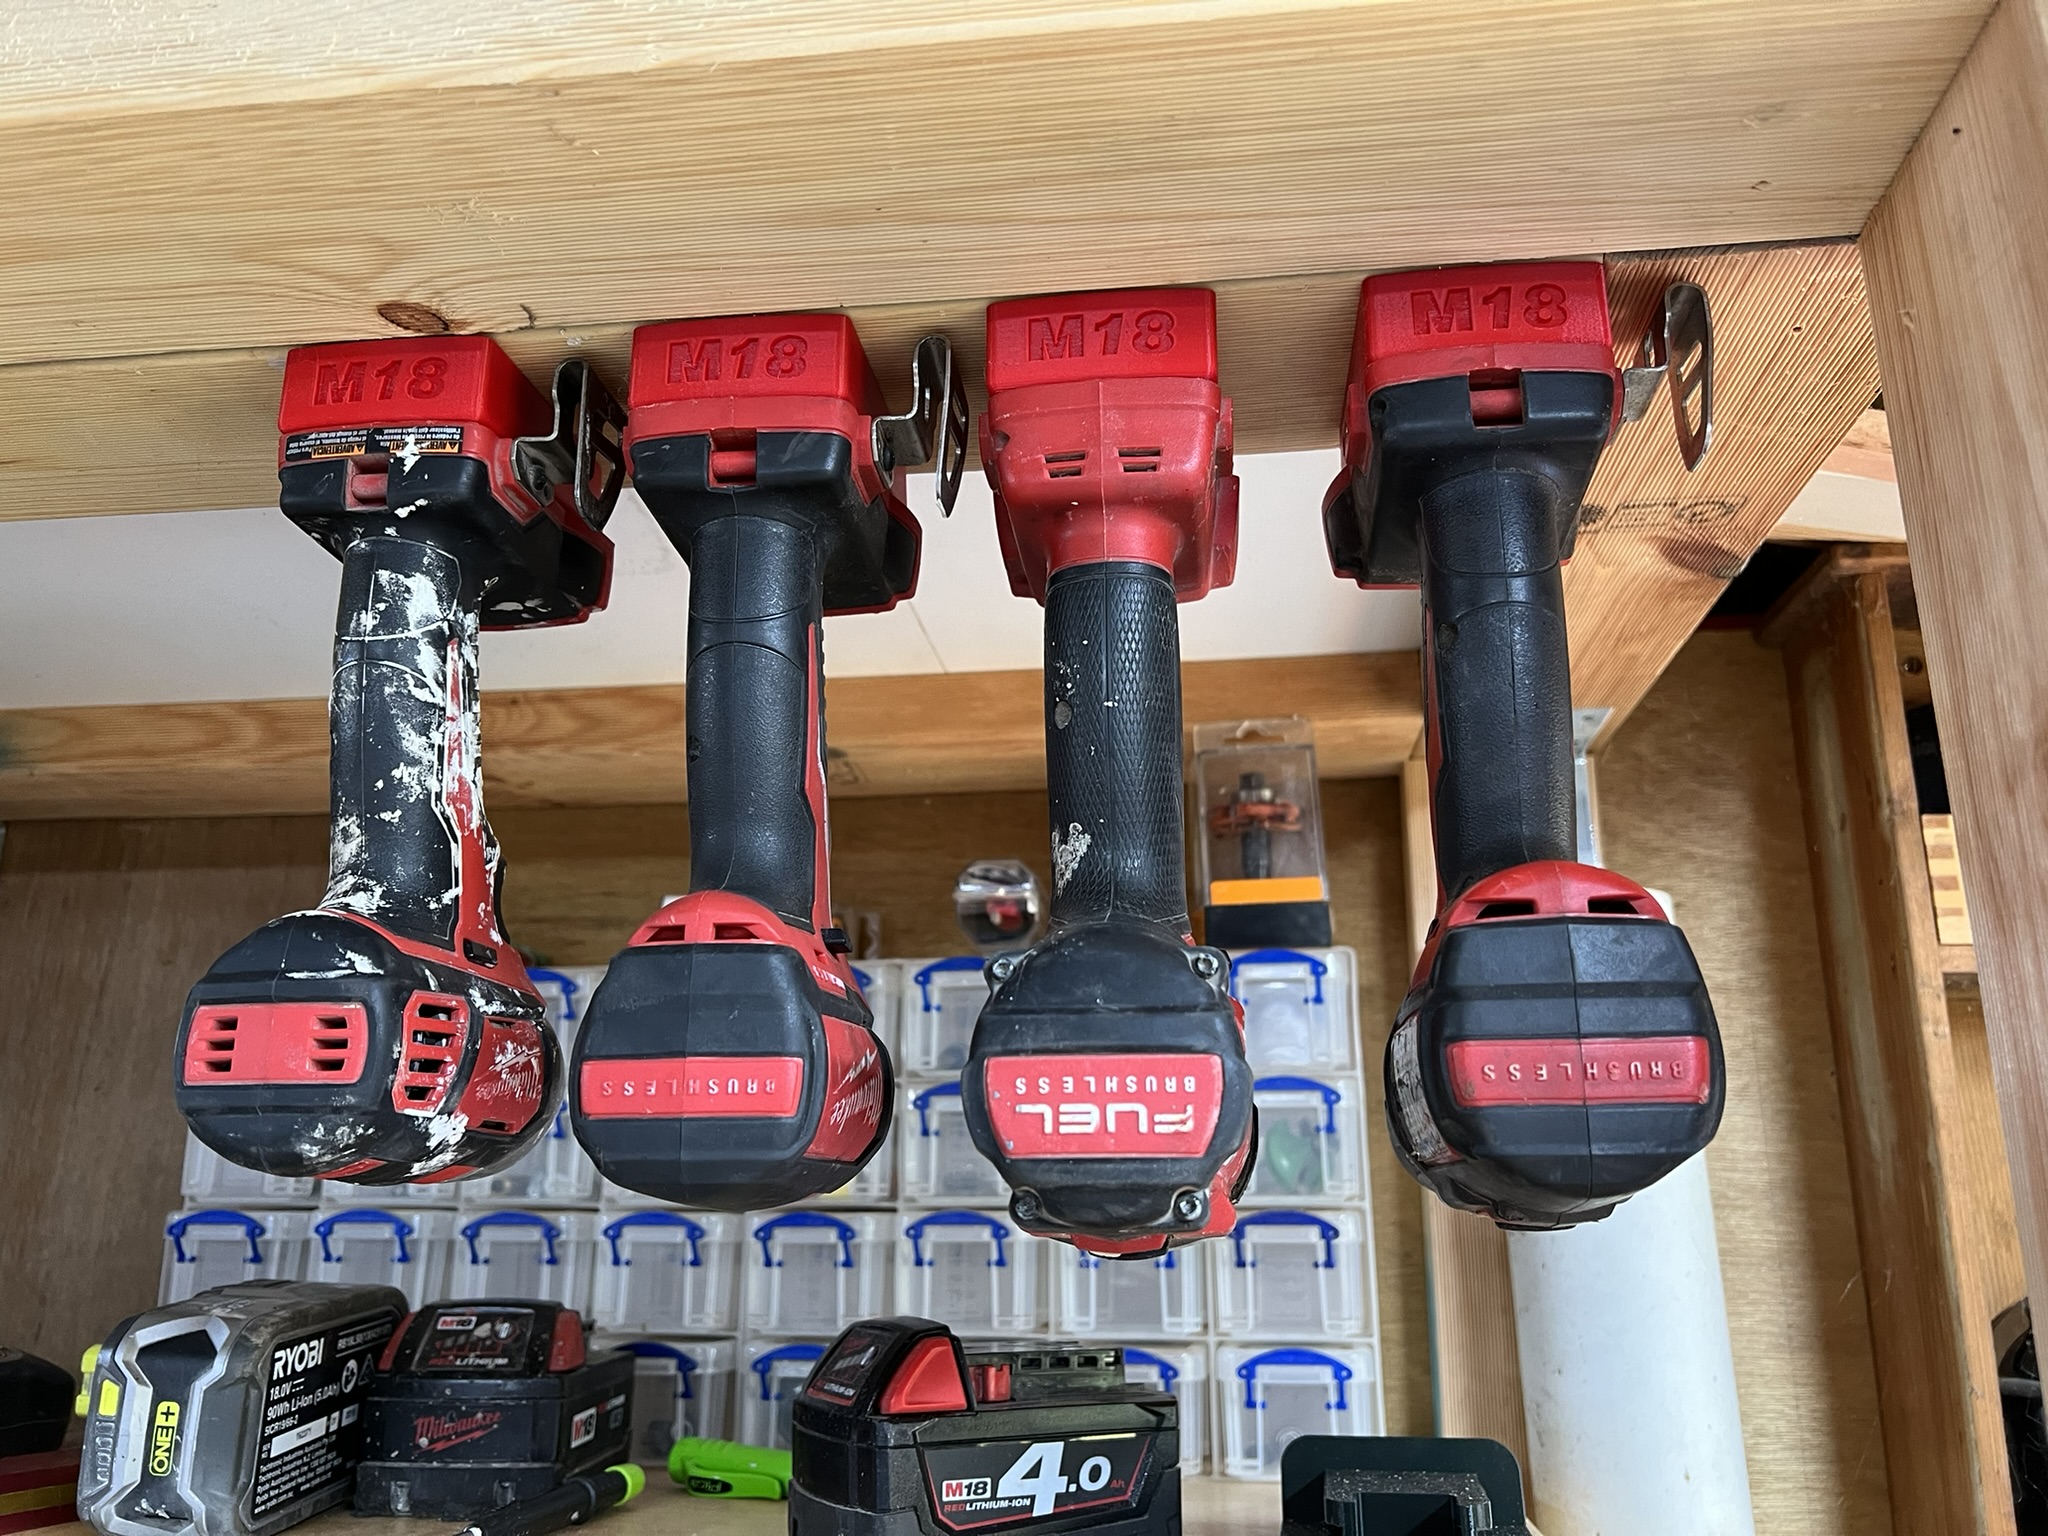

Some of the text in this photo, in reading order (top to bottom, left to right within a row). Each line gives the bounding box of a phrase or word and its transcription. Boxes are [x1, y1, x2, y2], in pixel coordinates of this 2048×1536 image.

[1410, 282, 1568, 335] M18
[1027, 310, 1176, 361] M18
[666, 334, 808, 385] M18
[312, 356, 448, 406] M18
[603, 1077, 776, 1096] BRUSHLESS
[1015, 1076, 1197, 1095] BRUSHLESS
[1481, 1060, 1685, 1085] BRUSHLESS
[1015, 1102, 1194, 1134] FUEL
[272, 1337, 325, 1380] RYOBI
[270, 1381, 292, 1401] 18.0V
[266, 1401, 290, 1421] 90Wh
[944, 1480, 989, 1498] M18
[996, 1441, 1126, 1517] 4.0 Ah
